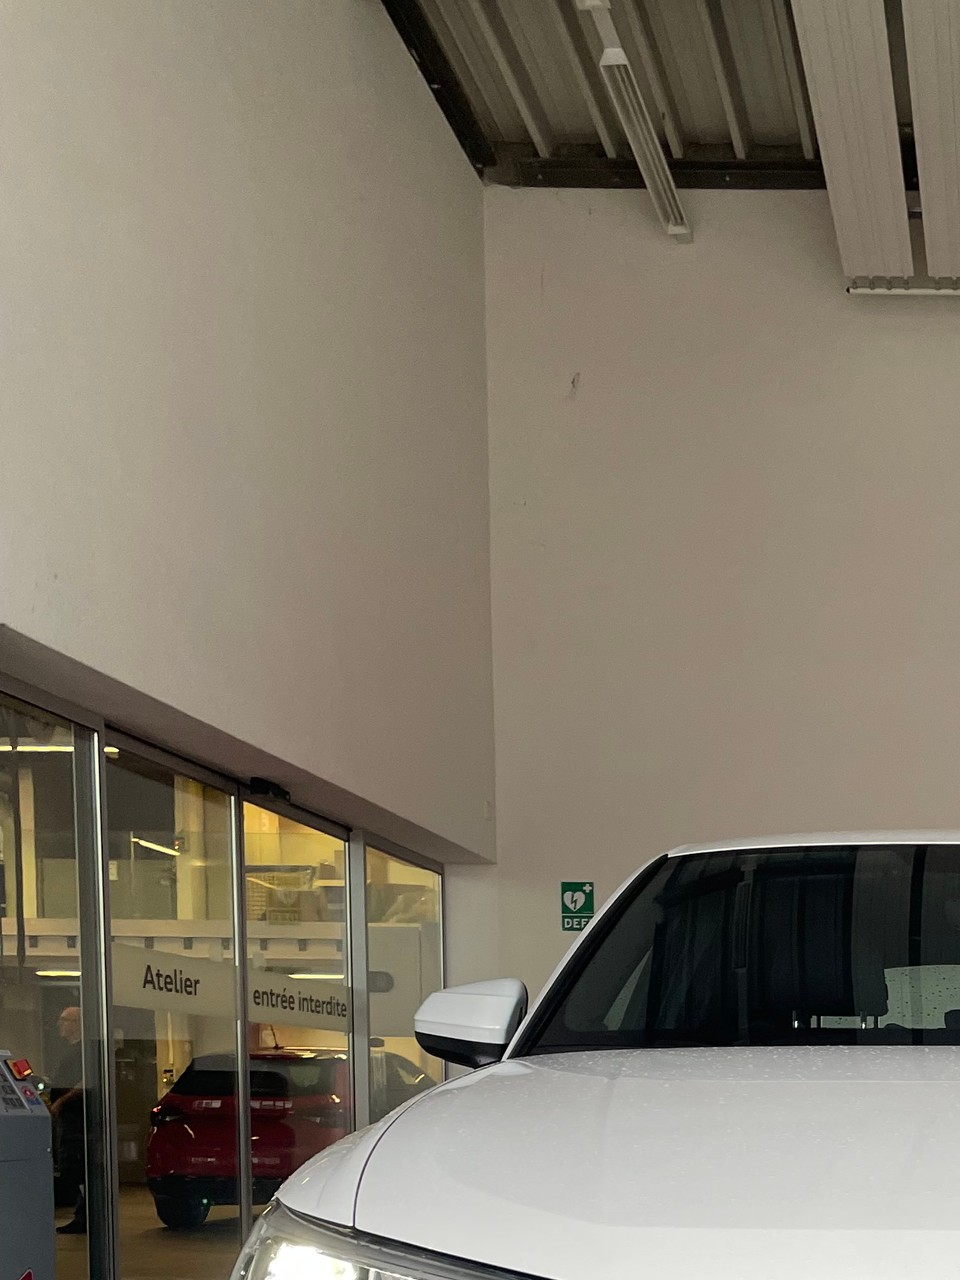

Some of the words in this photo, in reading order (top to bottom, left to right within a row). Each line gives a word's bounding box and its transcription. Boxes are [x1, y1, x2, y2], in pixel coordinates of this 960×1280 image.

[564, 918, 591, 928] DEF
[143, 965, 200, 995] Atelier
[253, 987, 295, 1011] entrée
[298, 991, 347, 1018] interdite
